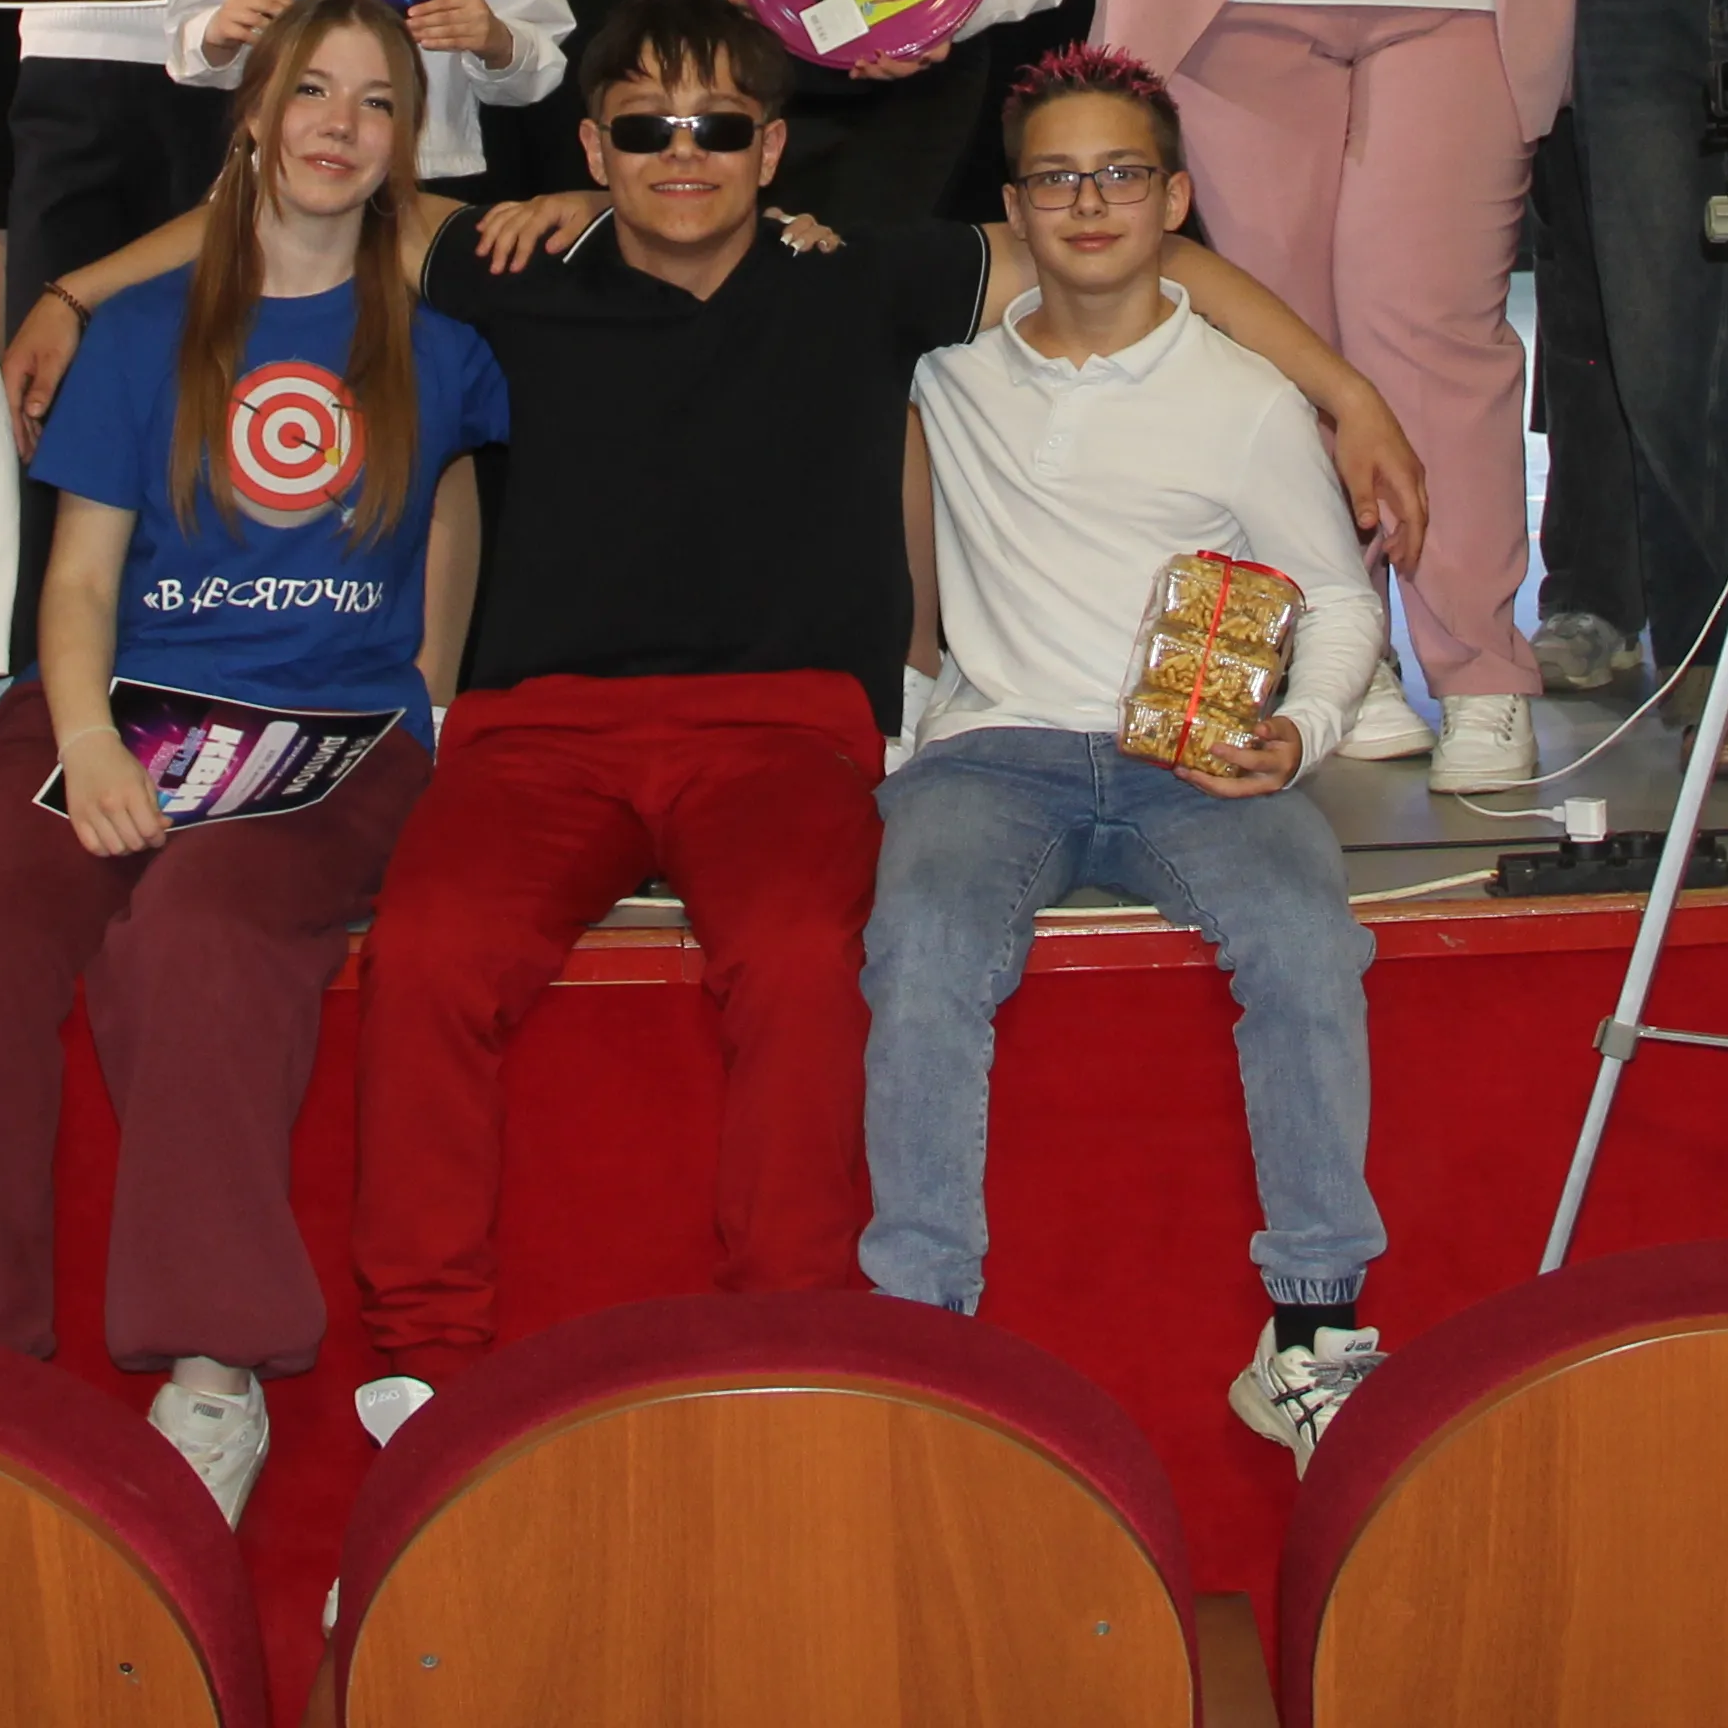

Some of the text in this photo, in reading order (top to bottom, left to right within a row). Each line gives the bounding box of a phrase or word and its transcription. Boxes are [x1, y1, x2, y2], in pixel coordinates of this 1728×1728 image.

[143, 578, 184, 611] «В
[162, 724, 244, 812] КВН
[281, 736, 347, 795] ДИПЛОМ
